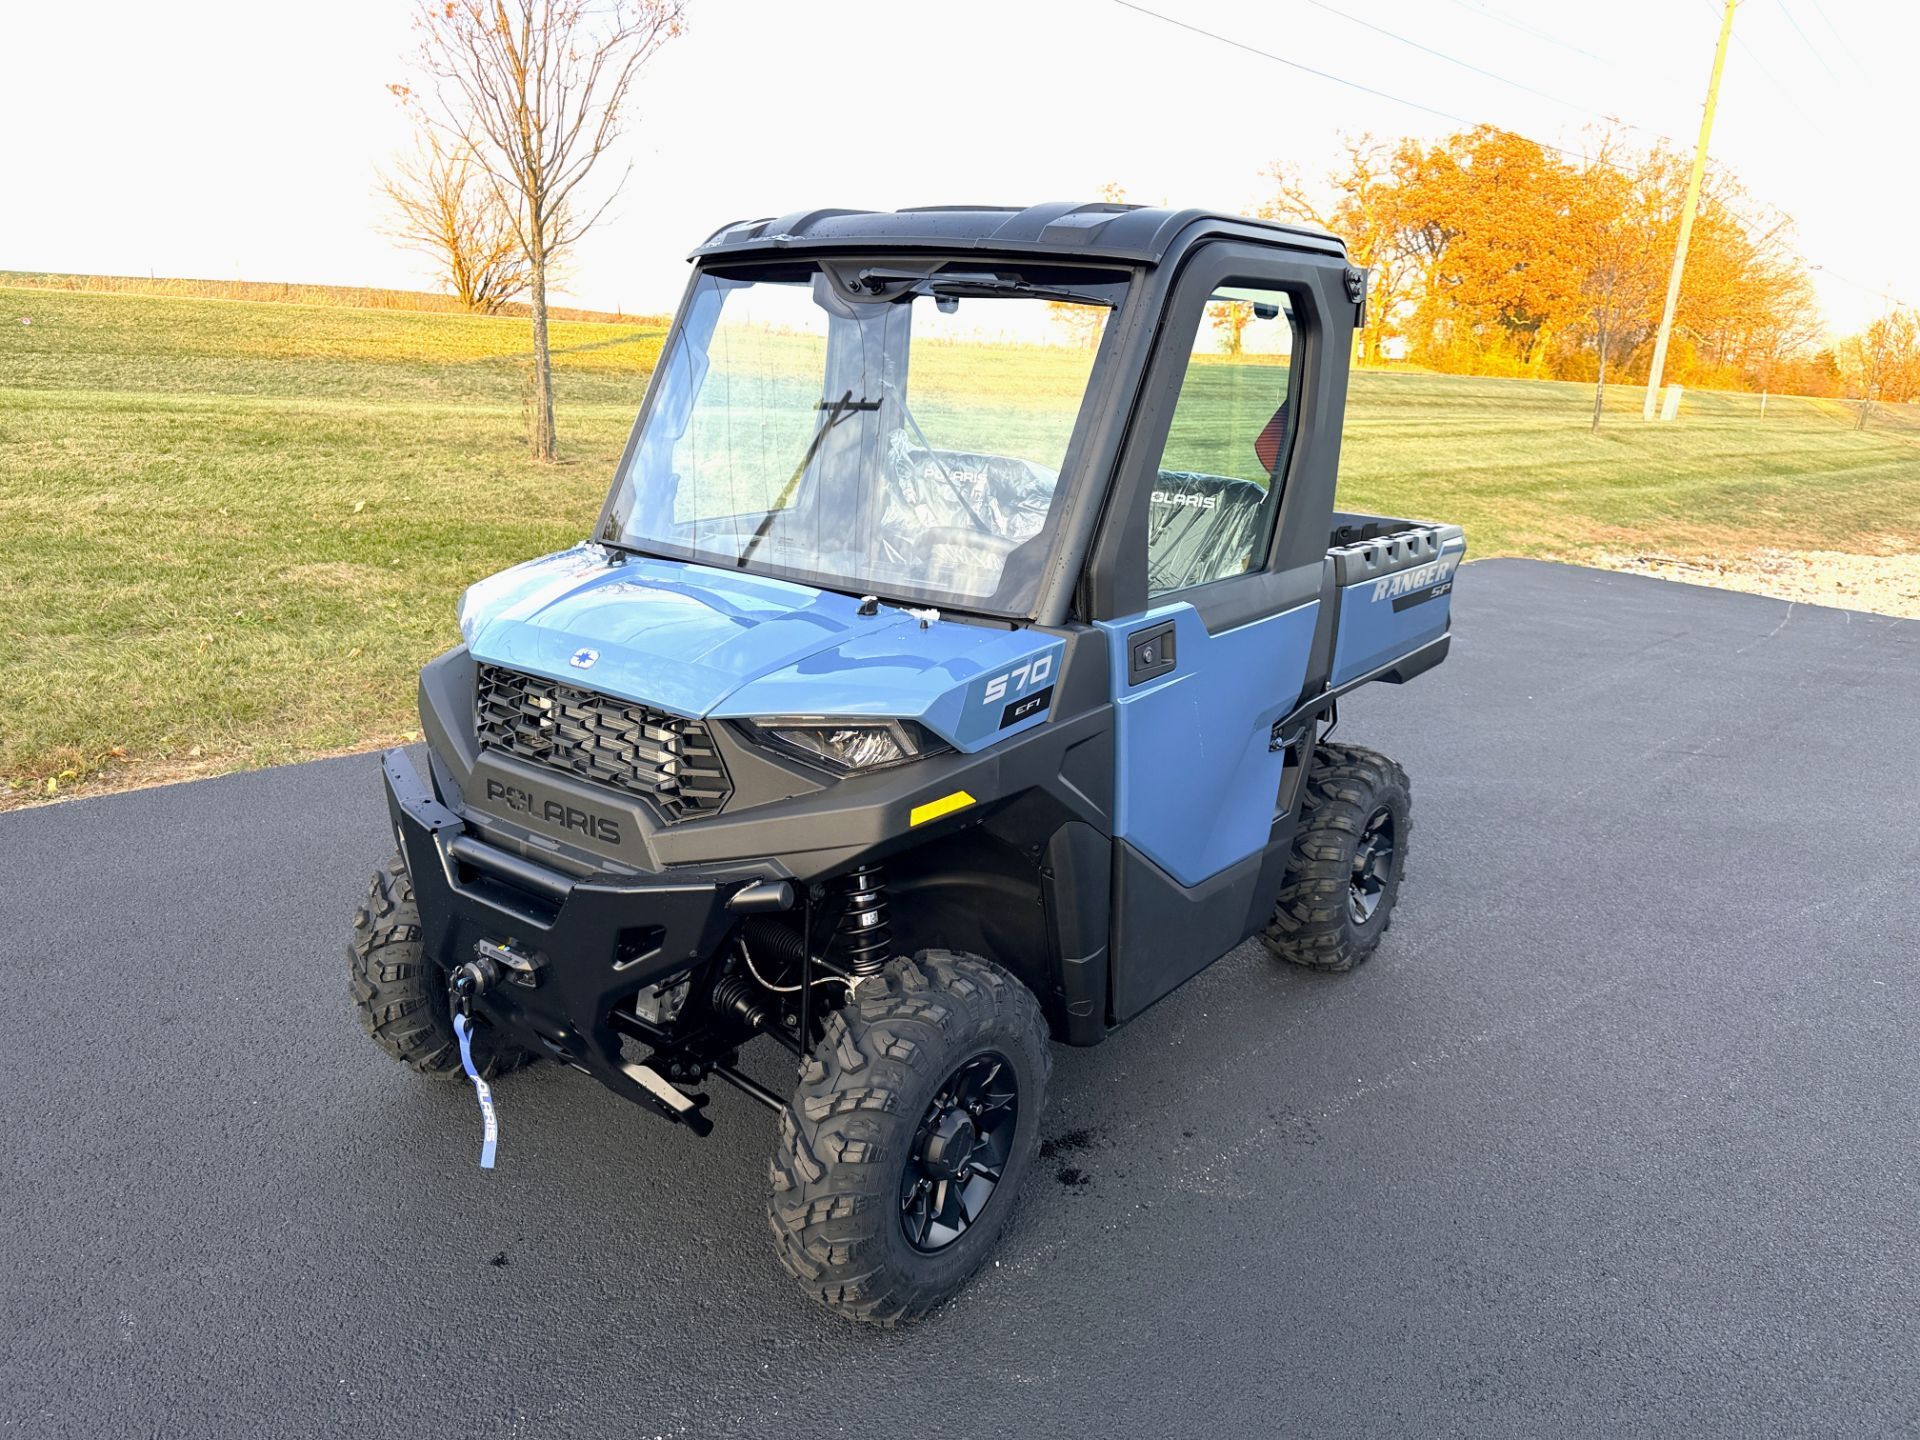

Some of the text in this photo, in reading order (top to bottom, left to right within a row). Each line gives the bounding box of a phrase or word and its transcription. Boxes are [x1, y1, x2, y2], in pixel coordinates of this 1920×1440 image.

[1371, 562, 1450, 603] RANGER
[1431, 583, 1452, 598] SP
[983, 655, 1053, 705] 570
[1015, 698, 1041, 716] EFI
[486, 778, 621, 845] POLARIS
